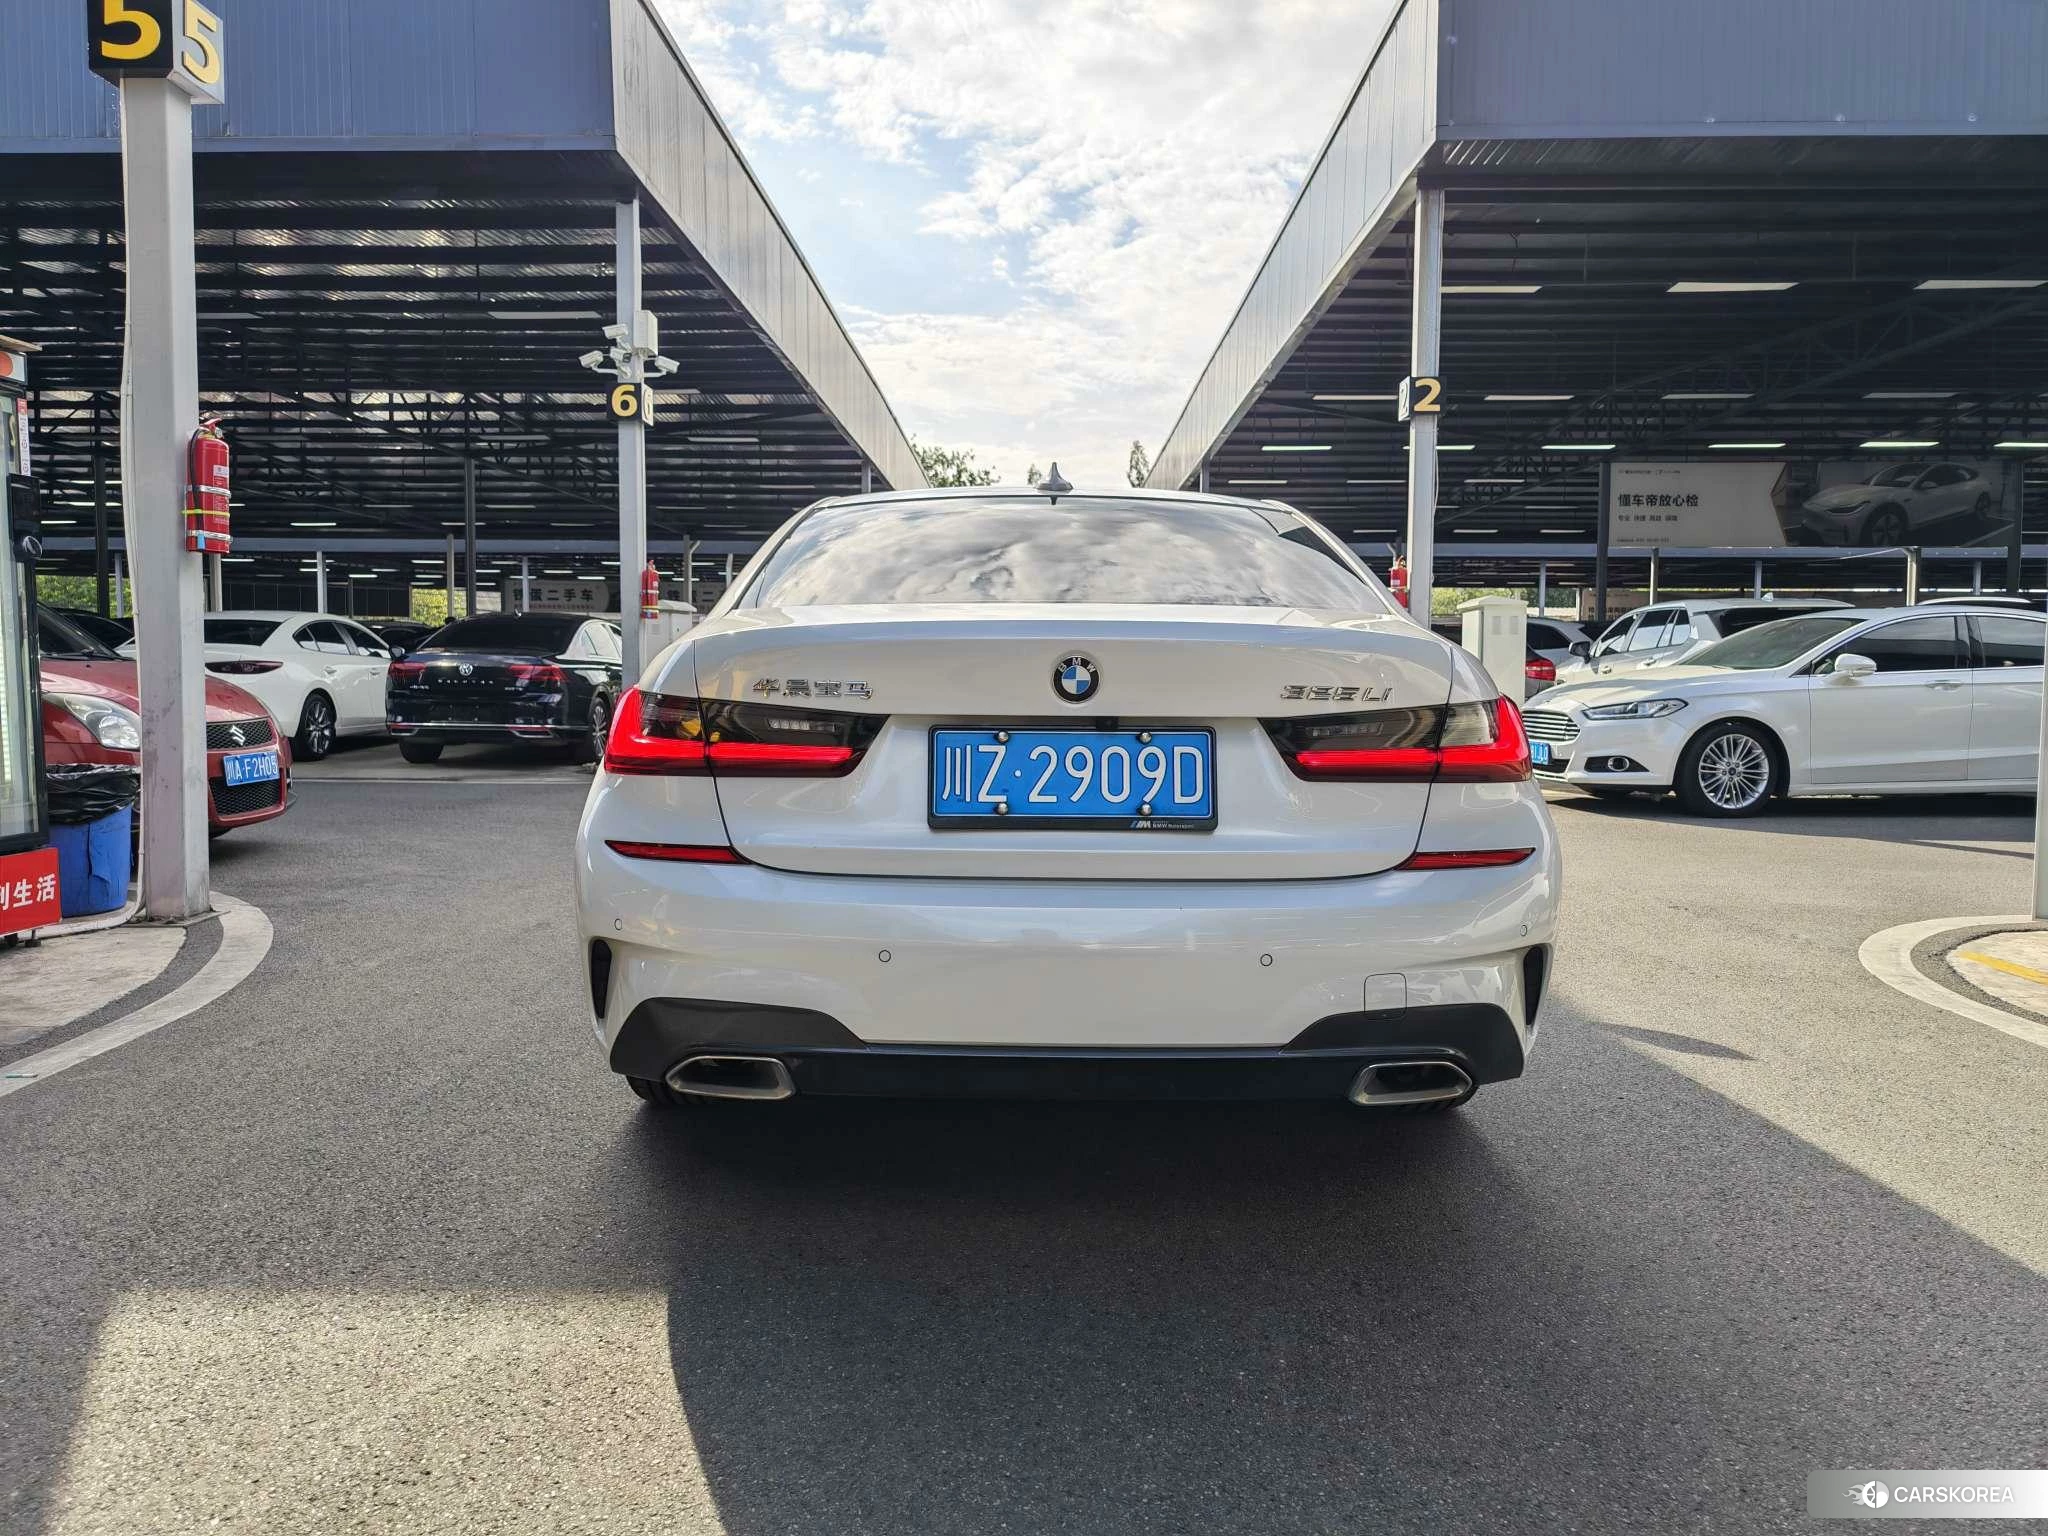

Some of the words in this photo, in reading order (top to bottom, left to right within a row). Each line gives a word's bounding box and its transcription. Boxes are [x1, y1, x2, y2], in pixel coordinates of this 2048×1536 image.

[101, 0, 161, 60] 5
[181, 0, 220, 85] 5
[611, 384, 638, 417] 6
[1413, 377, 1442, 412] 2
[1618, 493, 1699, 507] 懂车帝放心检
[1057, 657, 1096, 672] BMW
[752, 679, 873, 700] 华晨宝马
[942, 744, 1204, 804] 川Z·2909D
